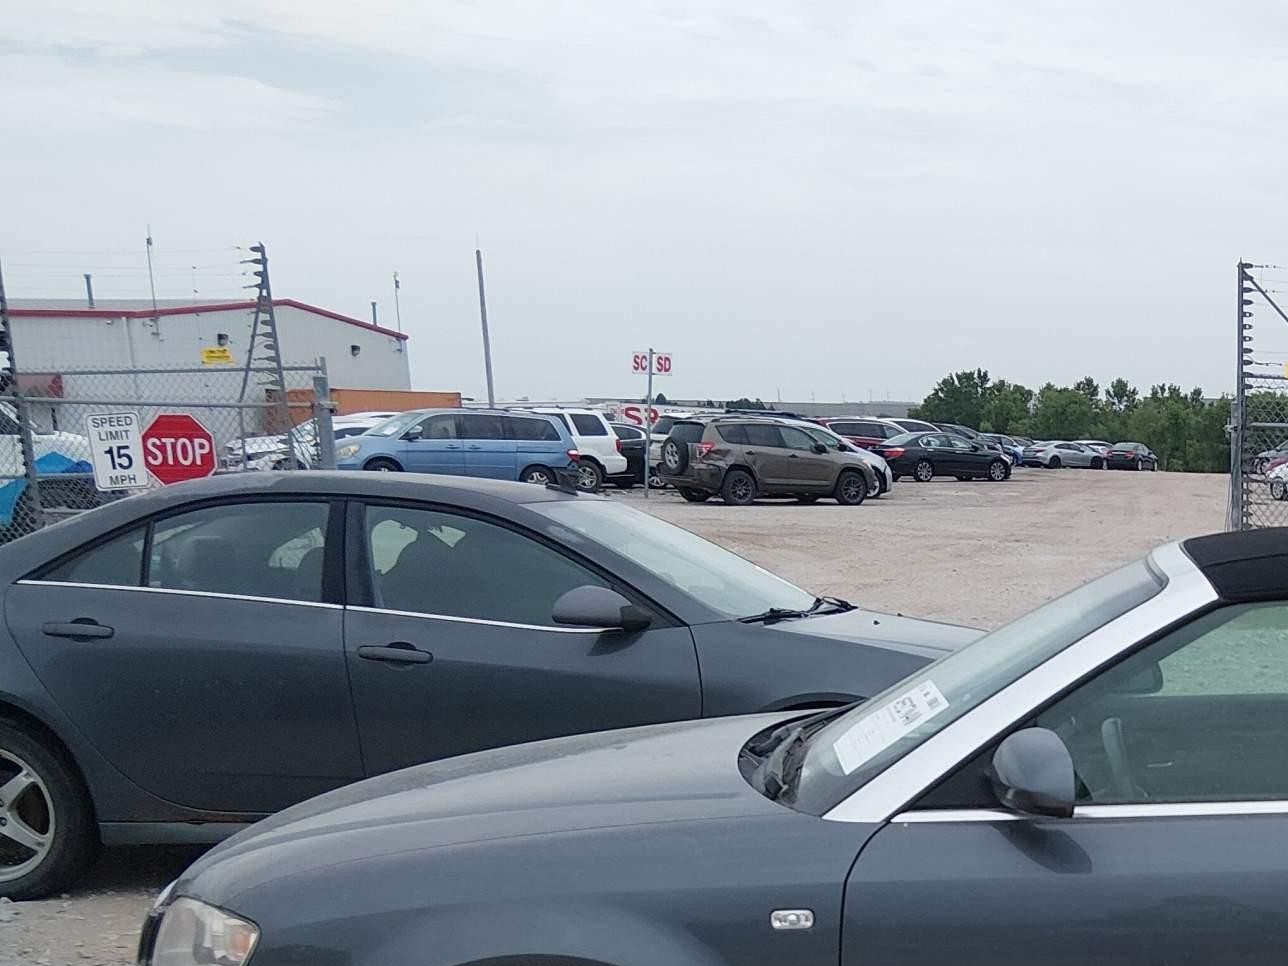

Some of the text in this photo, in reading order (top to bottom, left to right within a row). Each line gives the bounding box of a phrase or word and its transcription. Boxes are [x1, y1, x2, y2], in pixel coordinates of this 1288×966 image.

[632, 354, 648, 371] SC
[656, 356, 671, 373] SD
[91, 415, 133, 428] SPEED
[97, 429, 131, 442] LIMIT
[103, 444, 133, 470] 15
[146, 436, 211, 466] STOP
[109, 473, 137, 486] MPH
